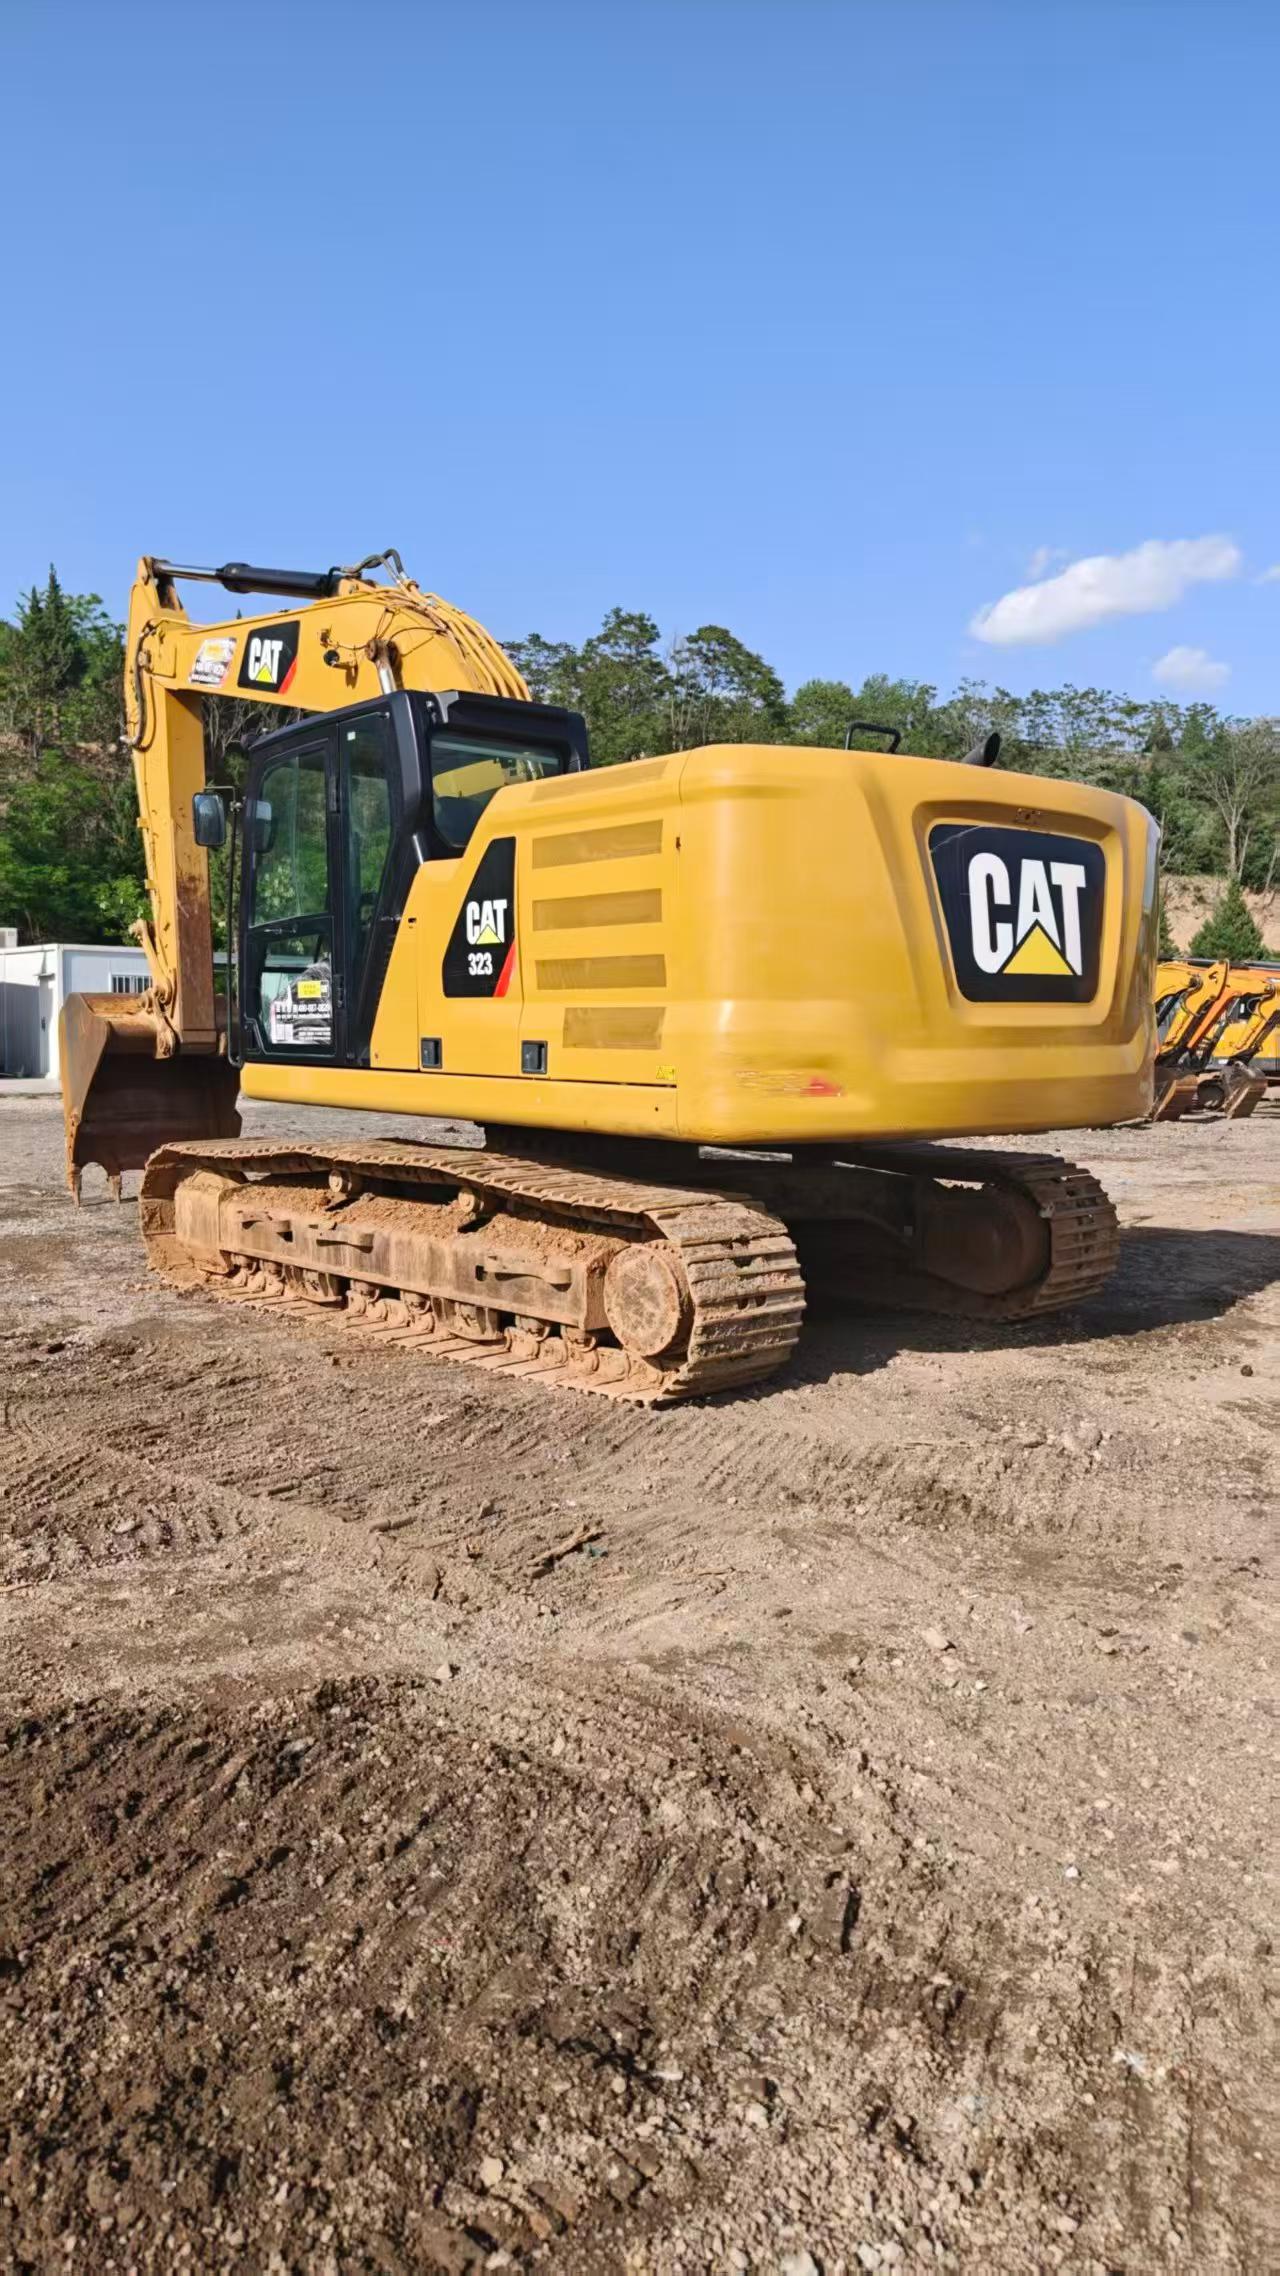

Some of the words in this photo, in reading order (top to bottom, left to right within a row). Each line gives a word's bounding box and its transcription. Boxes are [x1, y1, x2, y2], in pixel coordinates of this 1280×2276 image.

[248, 637, 283, 684] CAT
[466, 899, 507, 945] CAT
[968, 852, 1086, 976] CAT
[468, 952, 493, 976] 323
